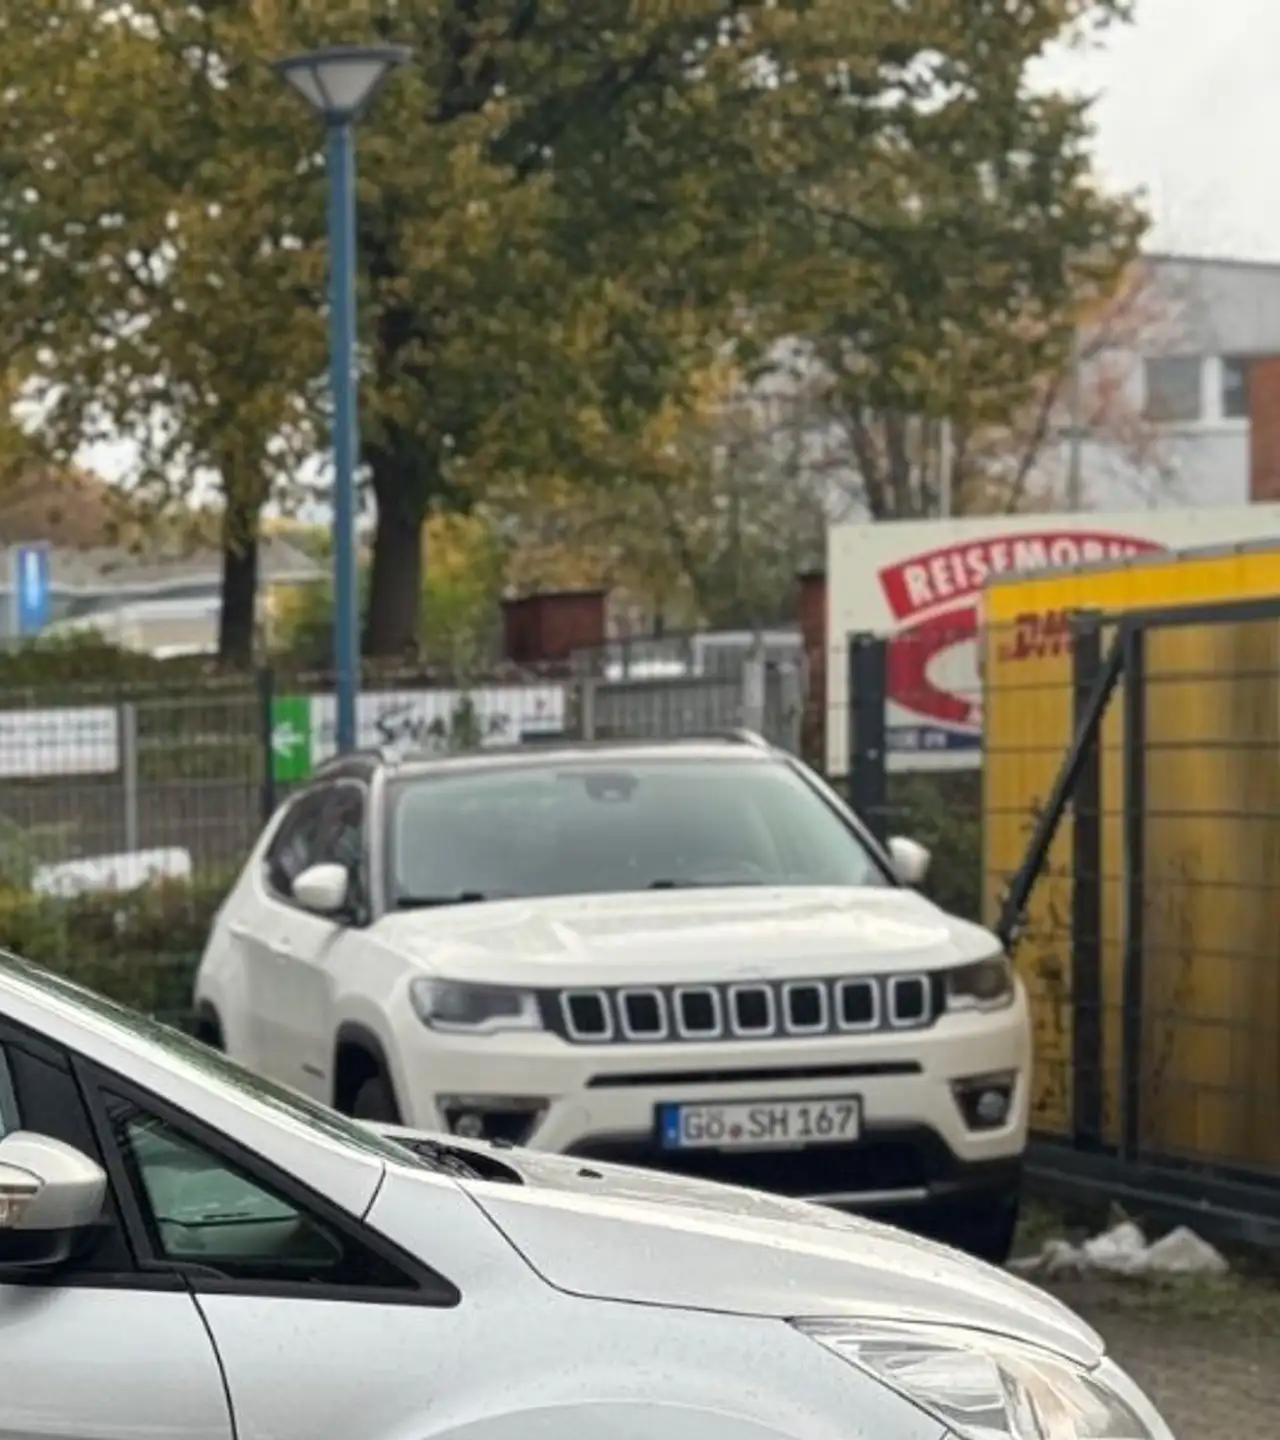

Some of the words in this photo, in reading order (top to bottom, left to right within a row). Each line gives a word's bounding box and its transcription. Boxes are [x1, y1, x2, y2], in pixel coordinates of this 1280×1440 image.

[684, 1107, 726, 1140] GÖ
[748, 1108, 789, 1138] SH
[797, 1104, 854, 1137] 167
